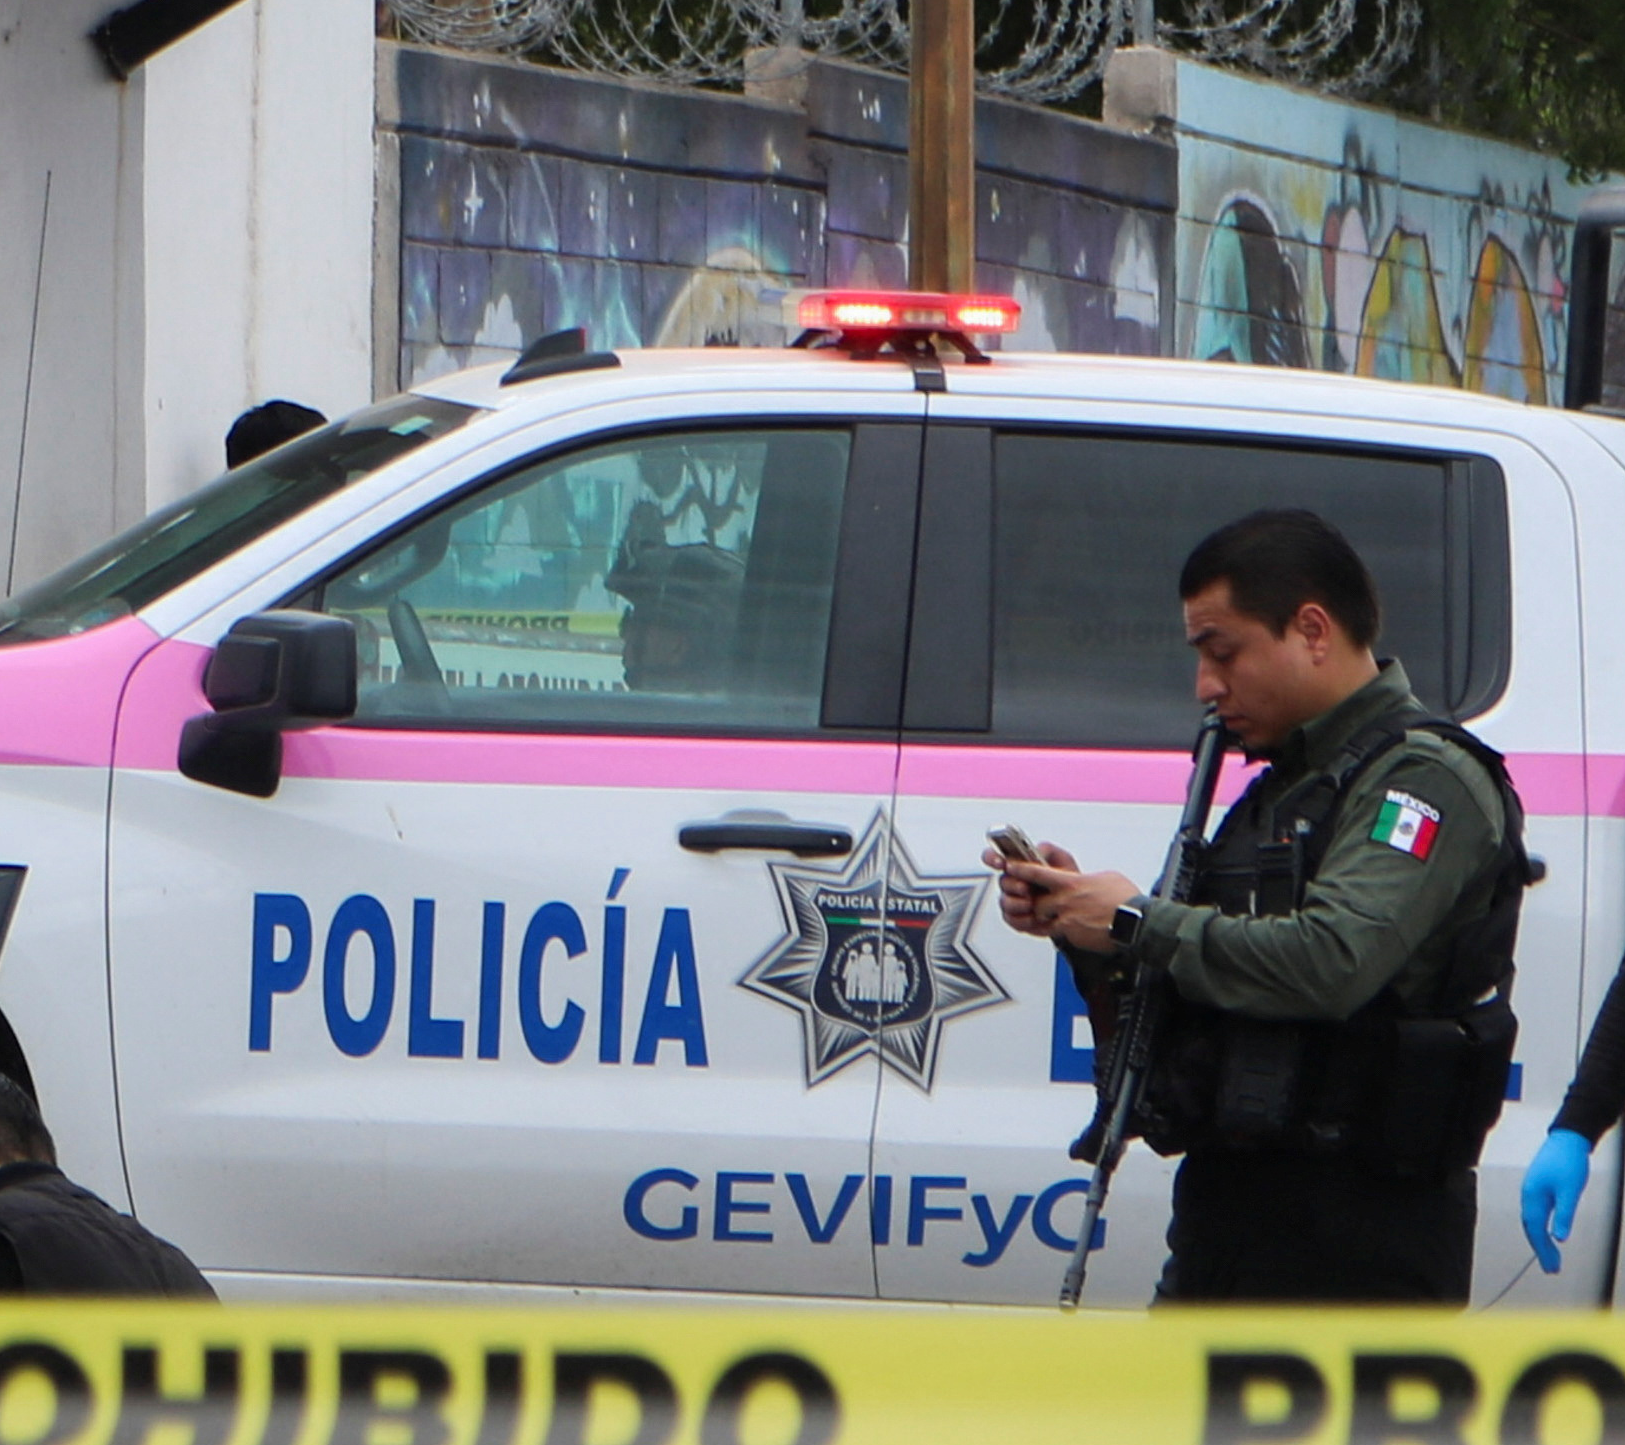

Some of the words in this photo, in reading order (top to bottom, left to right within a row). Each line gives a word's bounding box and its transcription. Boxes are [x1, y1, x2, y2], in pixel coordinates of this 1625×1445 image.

[817, 894, 875, 911] POLICÍA
[248, 867, 709, 1068] POLICÍA
[623, 1167, 1108, 1267] GEVIFyG
